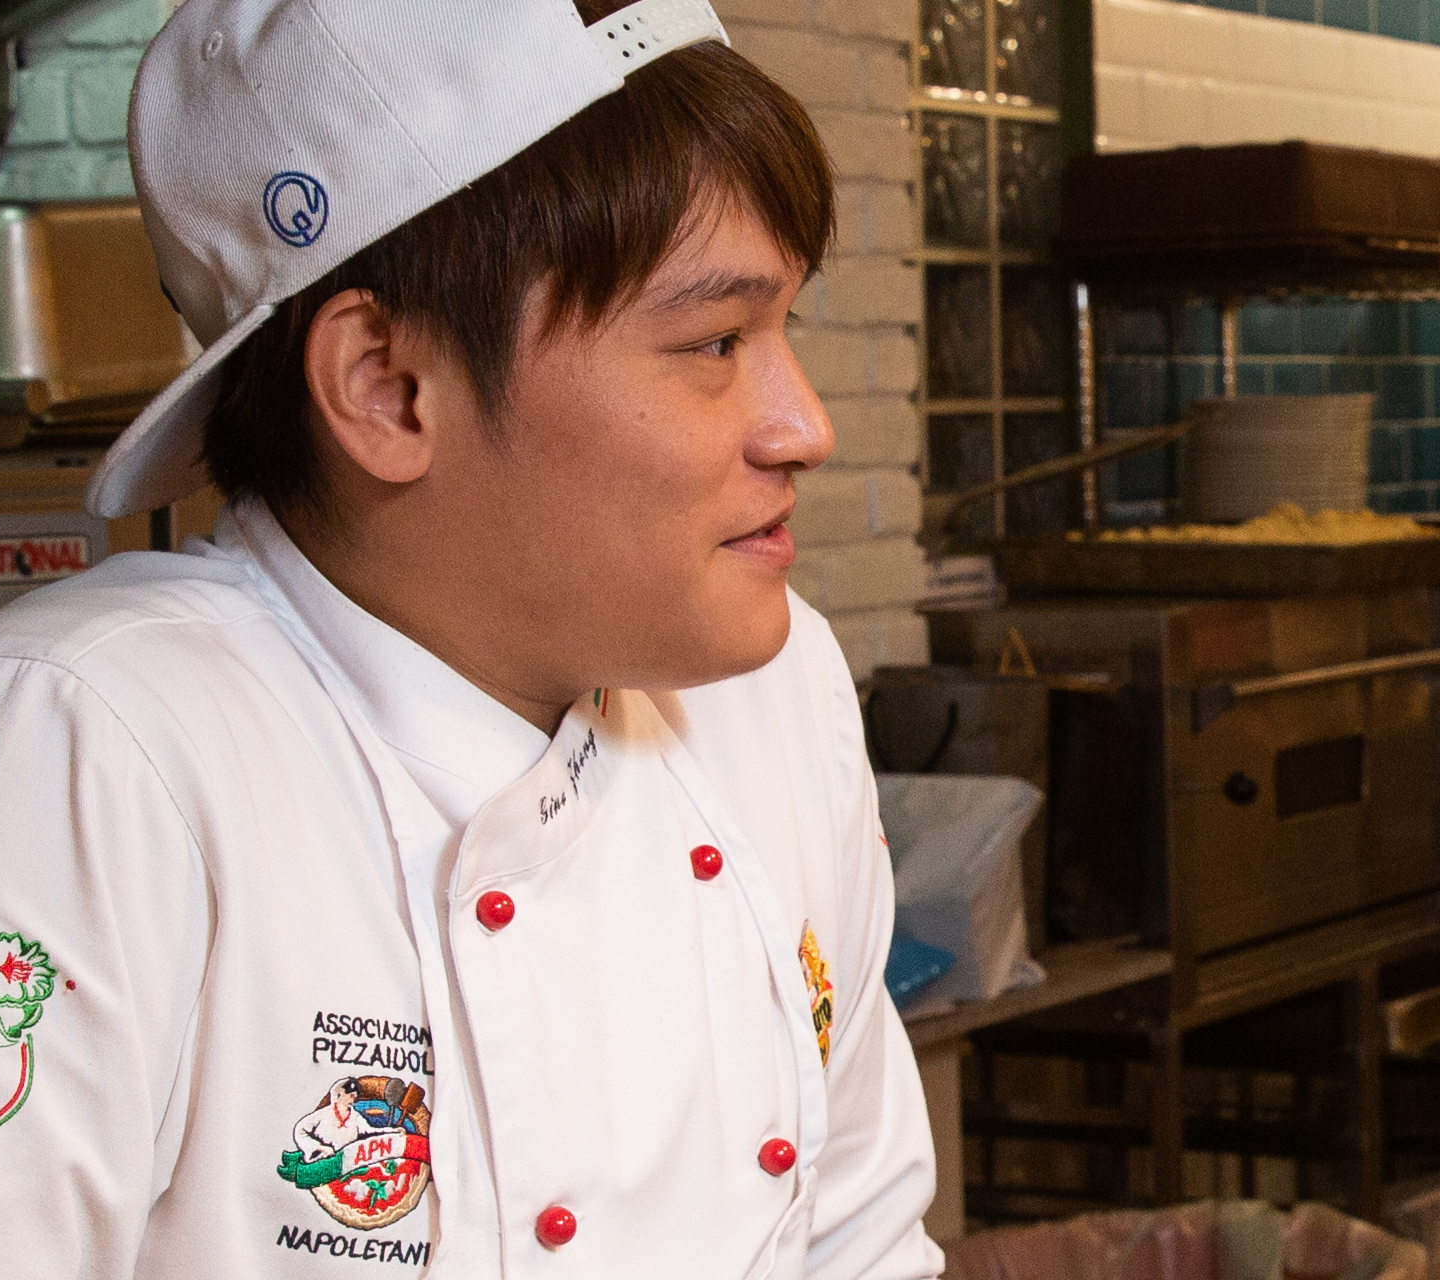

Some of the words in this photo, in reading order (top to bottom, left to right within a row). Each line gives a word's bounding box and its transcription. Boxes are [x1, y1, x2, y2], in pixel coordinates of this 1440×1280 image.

[313, 1011, 433, 1047] ASSOCIAZION
[312, 1037, 435, 1076] PIZZAIUOL
[353, 1136, 393, 1166] APN
[276, 1225, 431, 1267] NAPOLETANI
